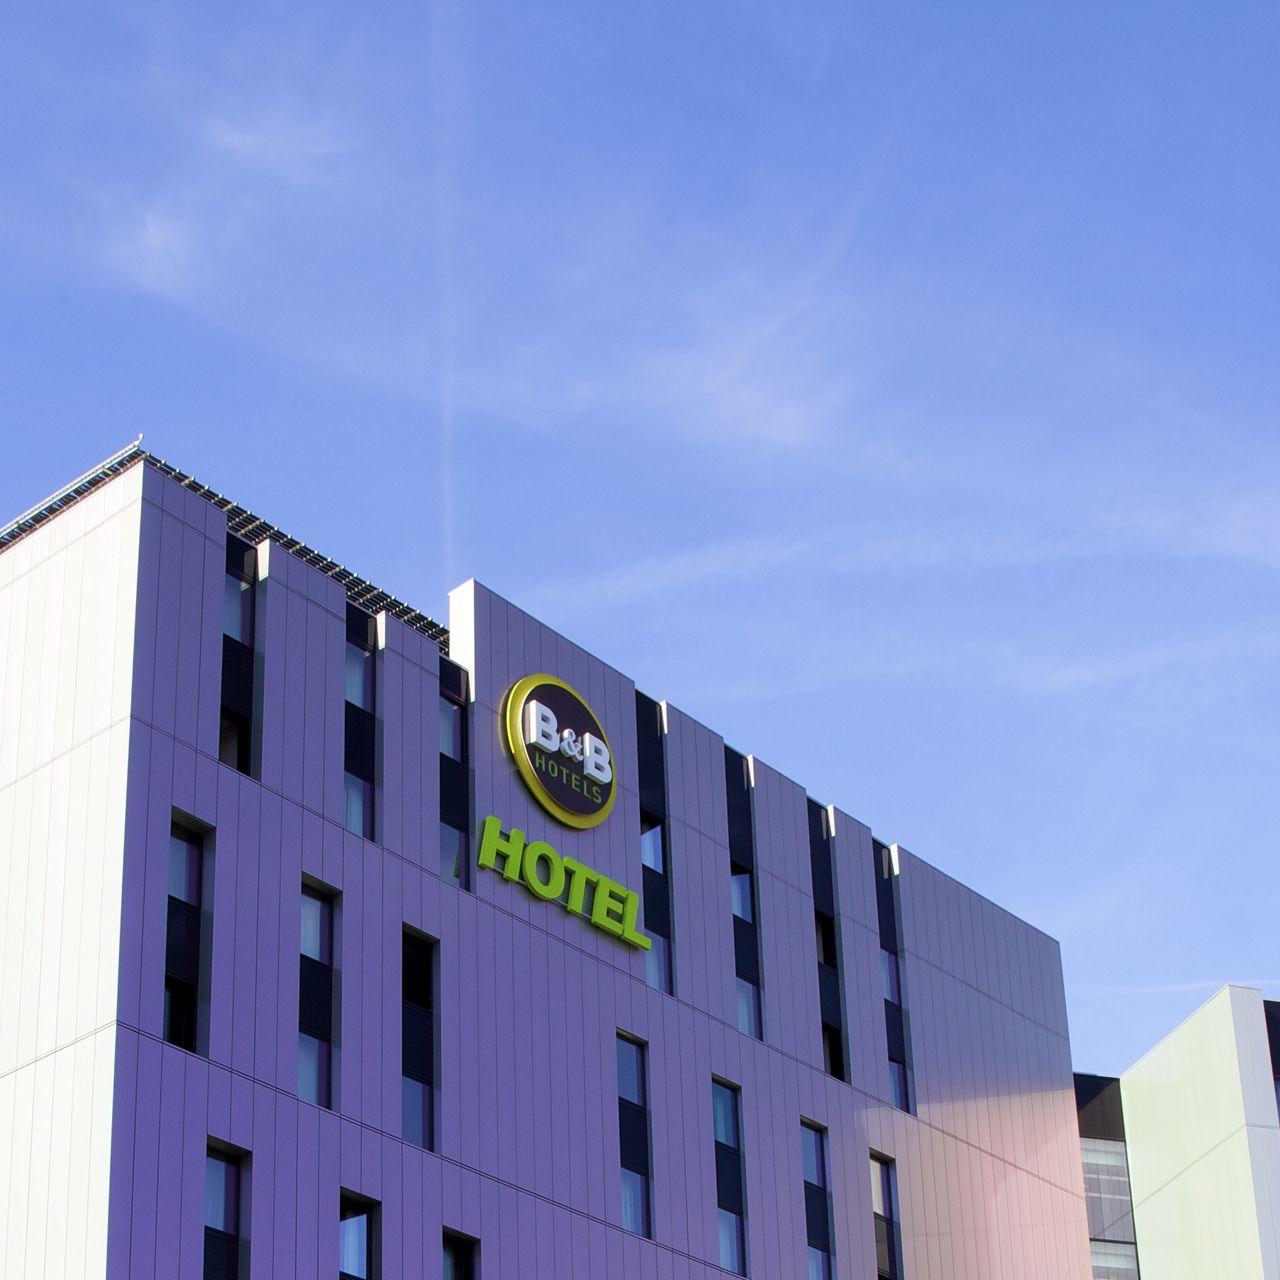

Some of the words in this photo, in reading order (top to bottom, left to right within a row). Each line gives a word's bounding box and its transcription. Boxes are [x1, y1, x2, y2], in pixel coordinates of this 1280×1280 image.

[525, 699, 613, 785] B&B
[535, 751, 603, 805] HOTELS
[477, 814, 653, 951] HOTEL
